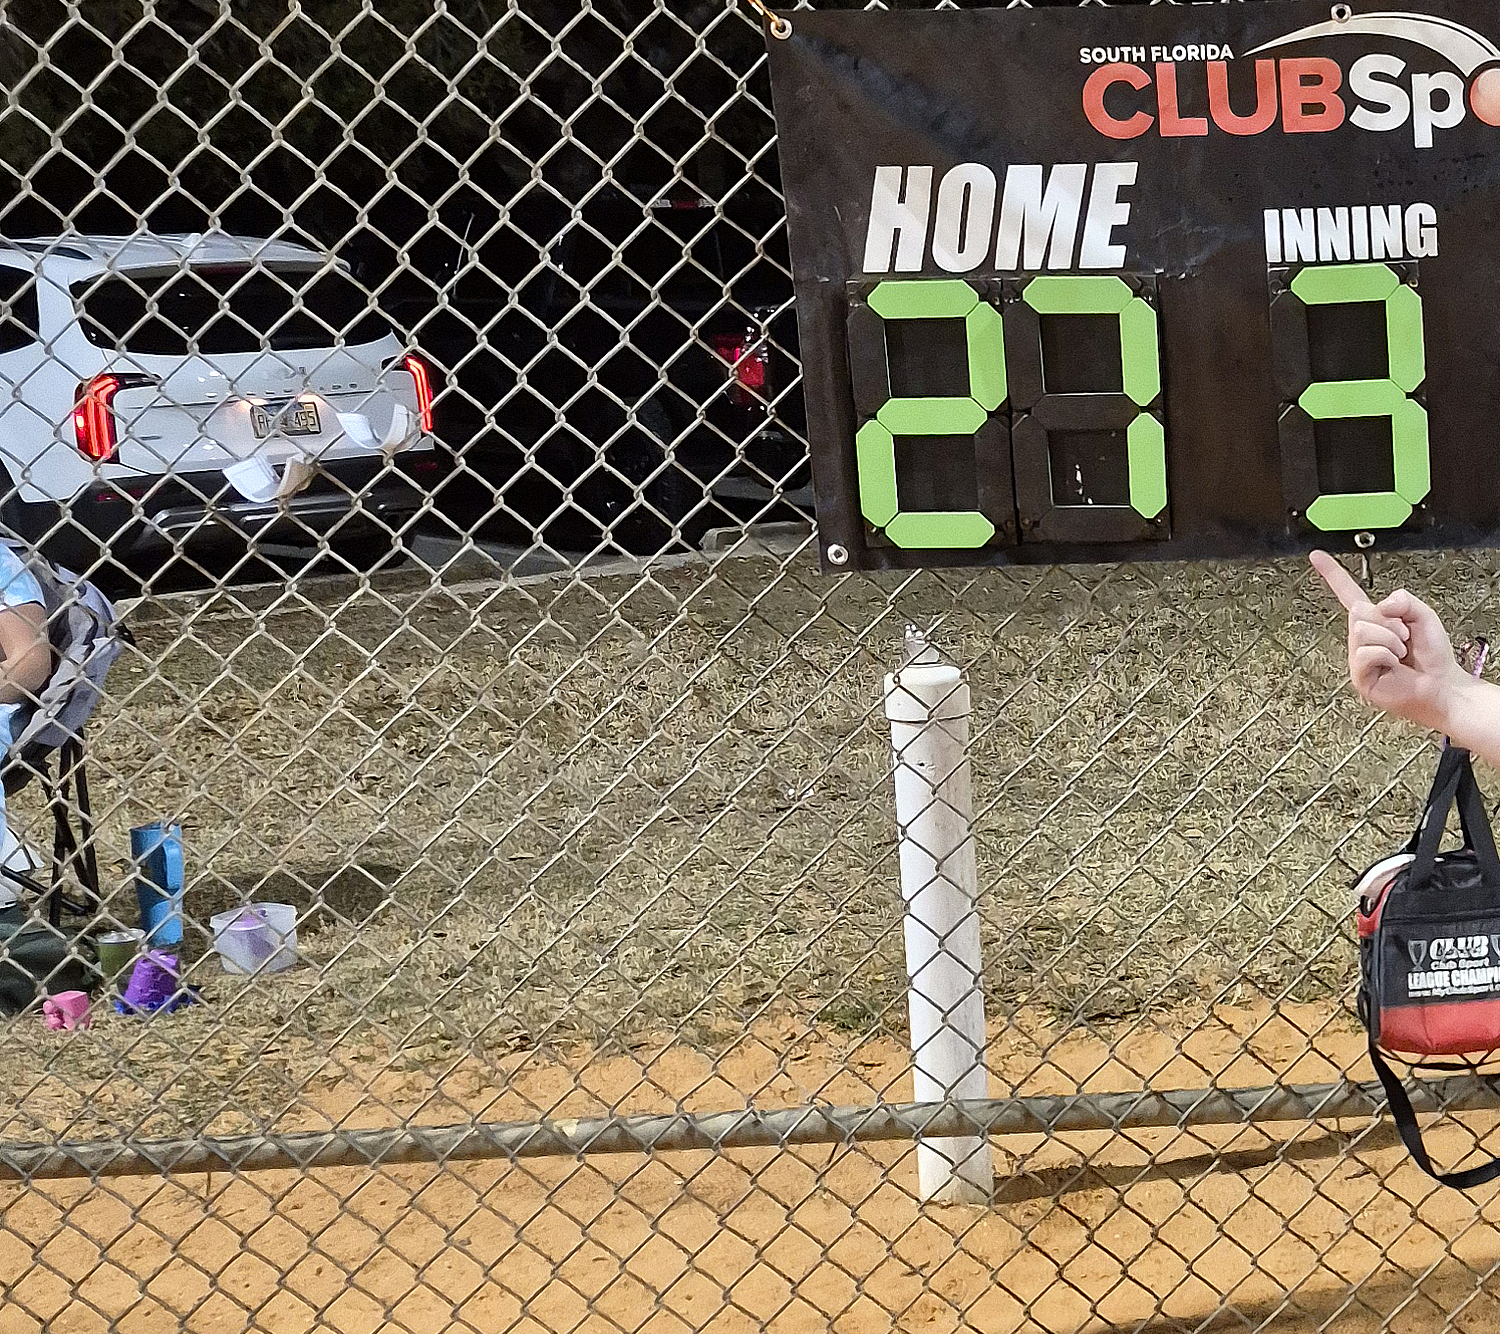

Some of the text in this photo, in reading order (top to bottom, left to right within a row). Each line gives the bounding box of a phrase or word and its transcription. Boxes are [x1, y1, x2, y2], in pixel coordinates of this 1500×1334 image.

[1079, 43, 1235, 64] SOUTH FLORIDA
[862, 161, 1138, 273] HOME
[1263, 202, 1440, 264] INNING
[855, 275, 1168, 548] 27
[1290, 262, 1433, 532] 3
[1429, 935, 1489, 960] CLUB
[1407, 970, 1451, 990] LEAGUE
